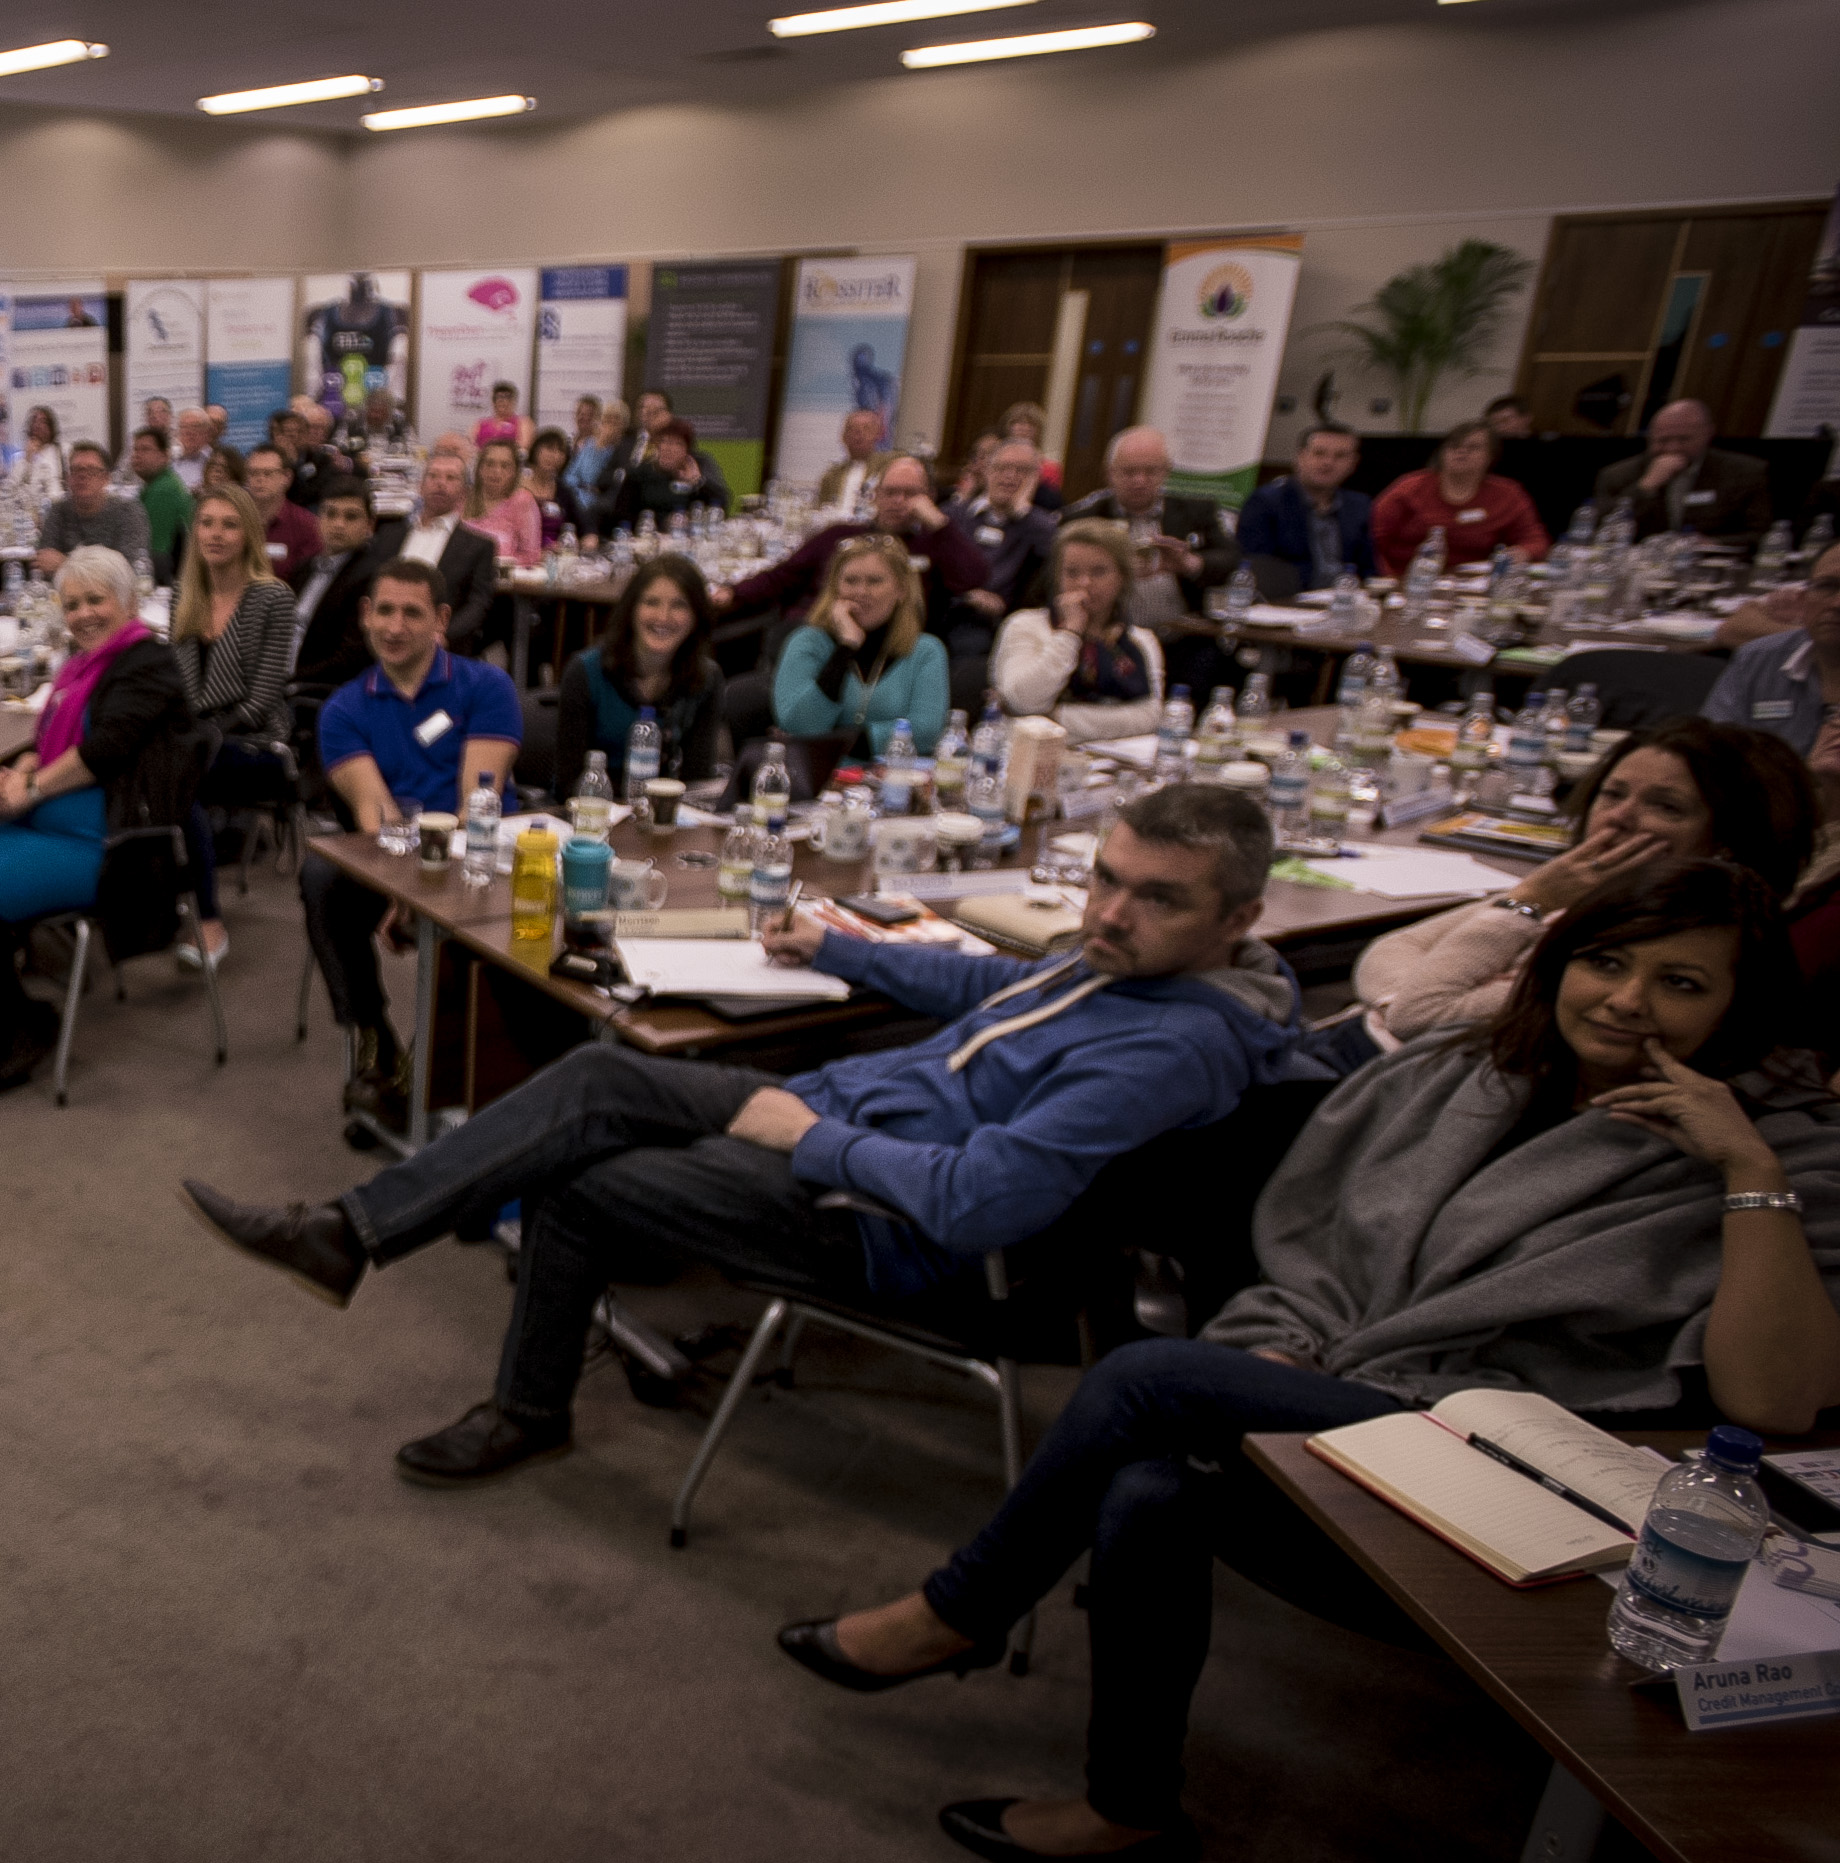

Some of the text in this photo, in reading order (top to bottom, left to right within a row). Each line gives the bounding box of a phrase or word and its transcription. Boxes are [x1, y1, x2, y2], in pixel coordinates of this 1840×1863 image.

[1693, 1663, 1793, 1691] Aruna Rao
[1698, 1695, 1738, 1712] Credit
[1739, 1684, 1823, 1707] Management
